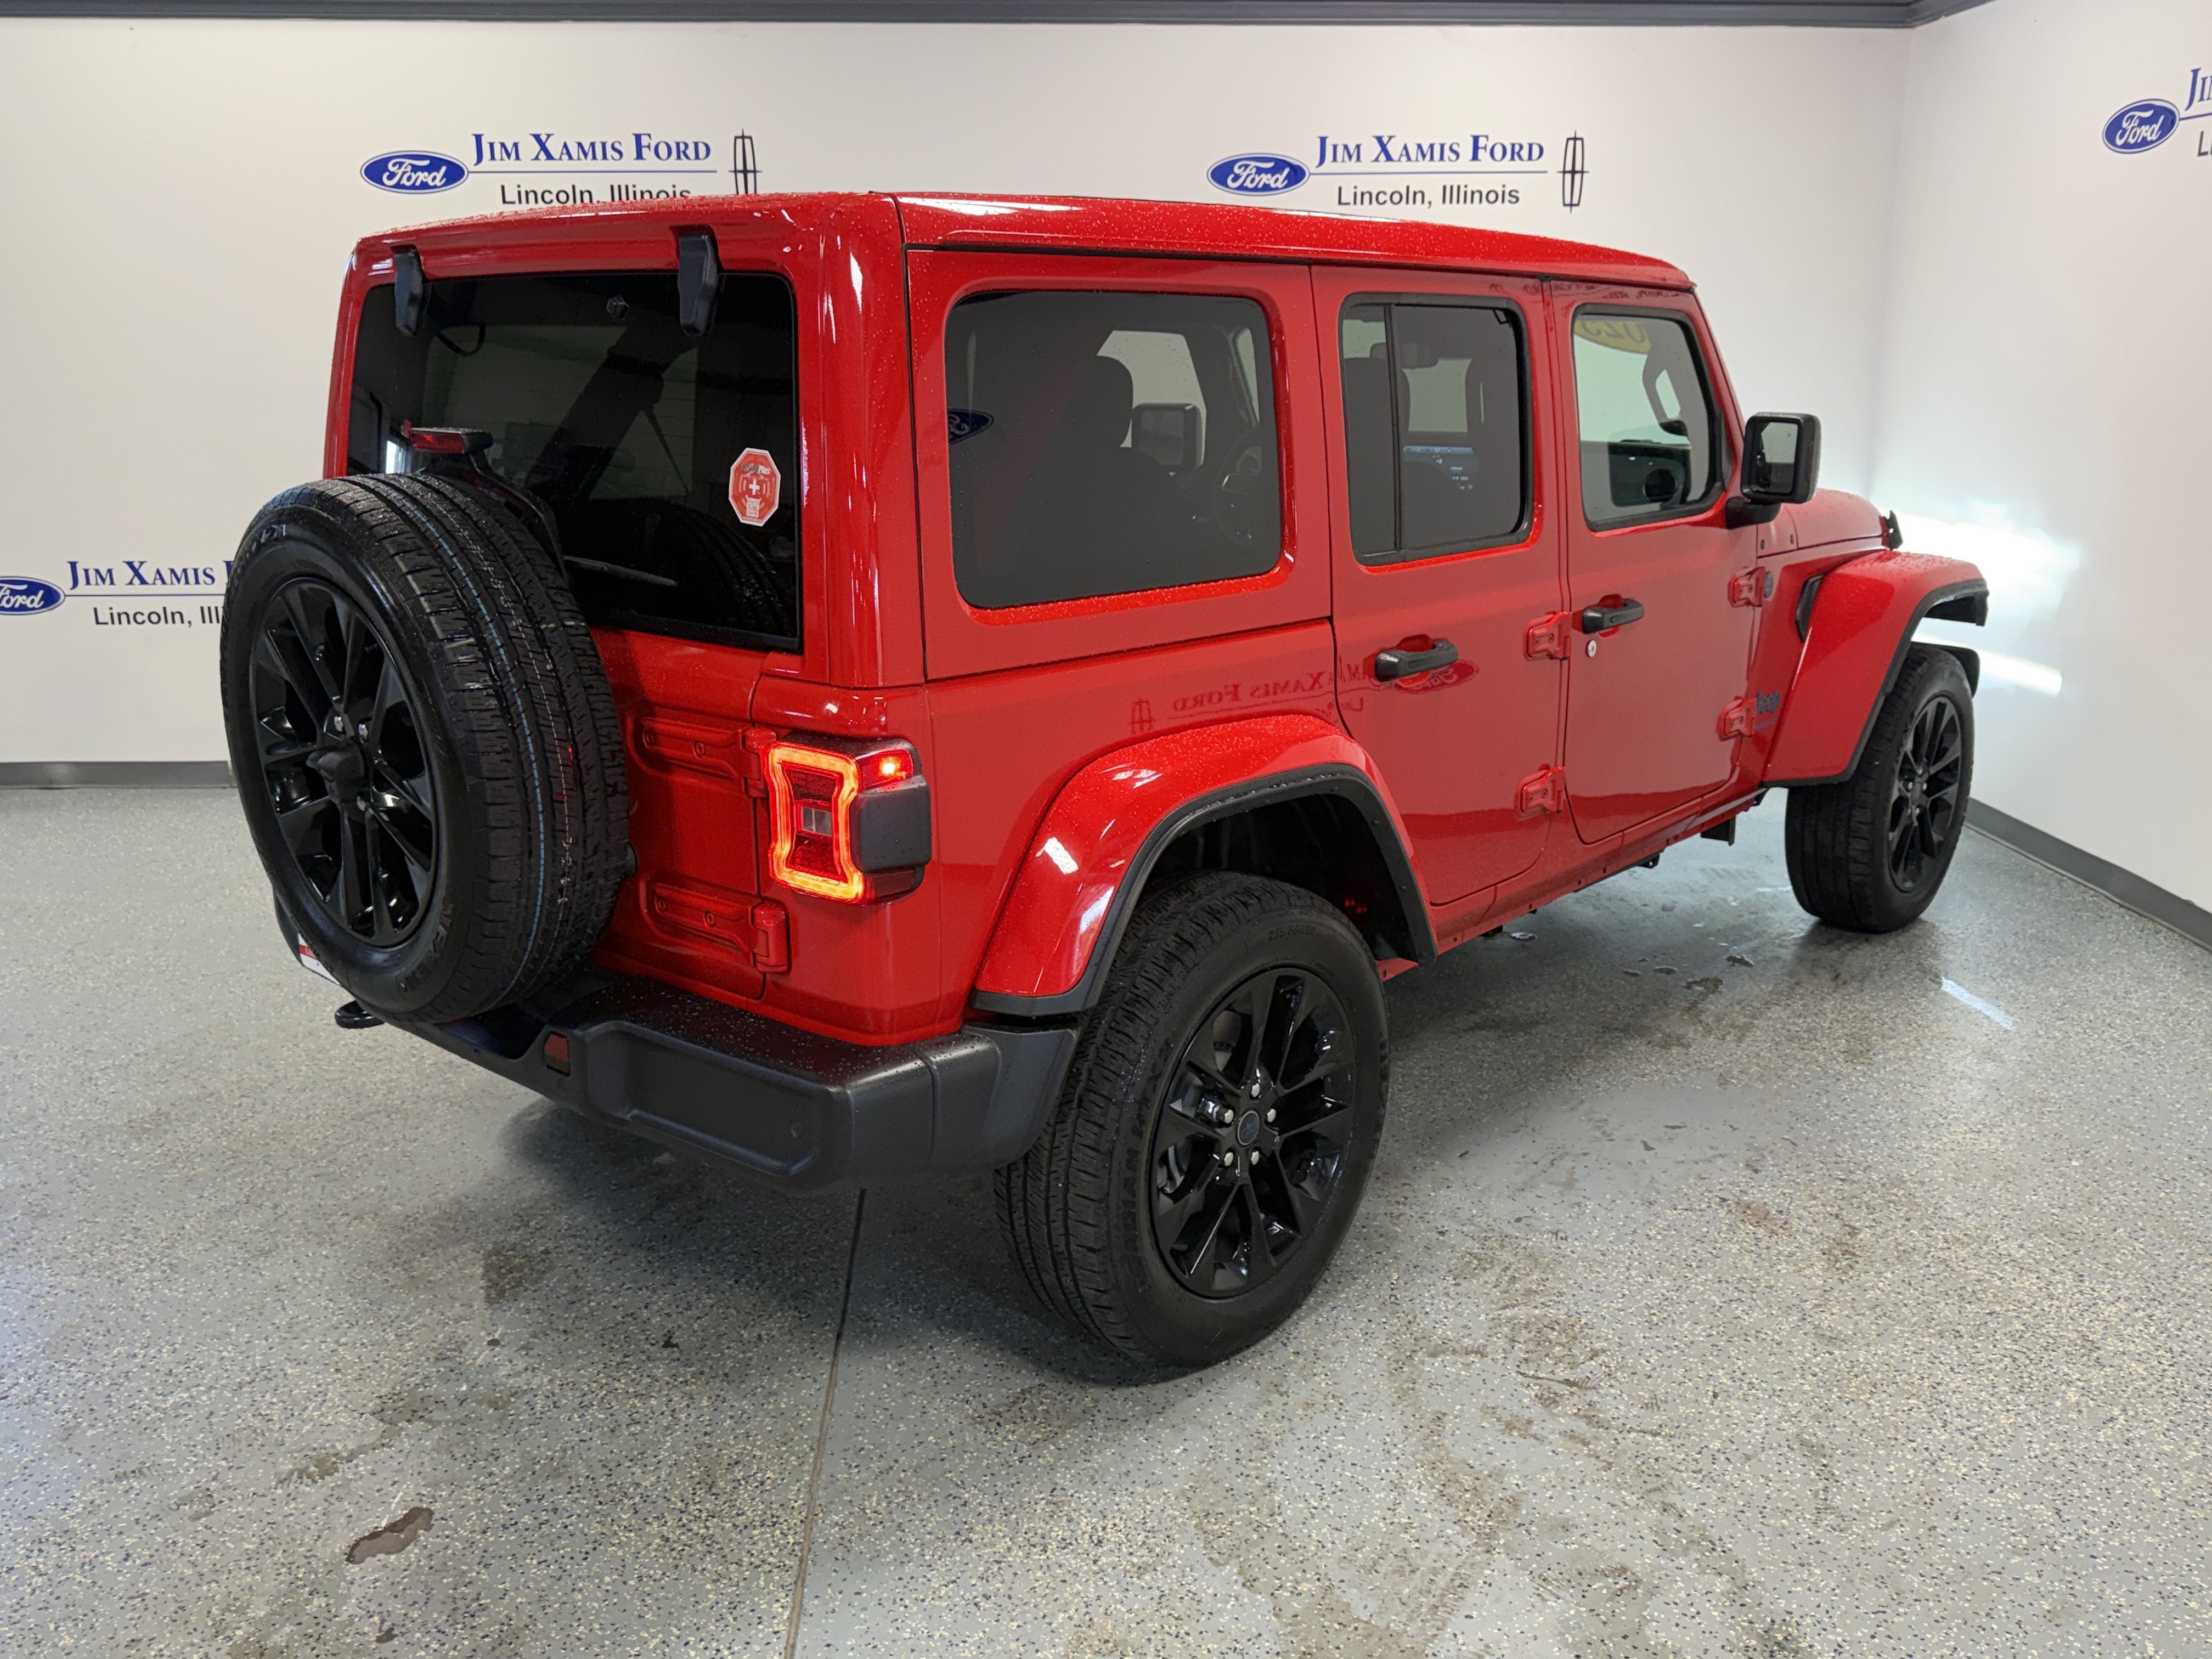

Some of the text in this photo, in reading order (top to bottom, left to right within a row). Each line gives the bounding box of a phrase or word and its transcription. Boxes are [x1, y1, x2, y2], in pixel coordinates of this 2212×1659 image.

[2115, 109, 2165, 146] Ford
[471, 133, 711, 166] JIM XAMIS FORD
[1316, 135, 1544, 168] JIM XAMIS FORD
[382, 158, 447, 186] Ford
[1227, 160, 1290, 188] Ford
[1338, 184, 1520, 208] Lincoln, Illinois
[66, 561, 116, 591] JIM
[122, 561, 216, 586] XAMIS
[93, 606, 192, 628] Lincoln,
